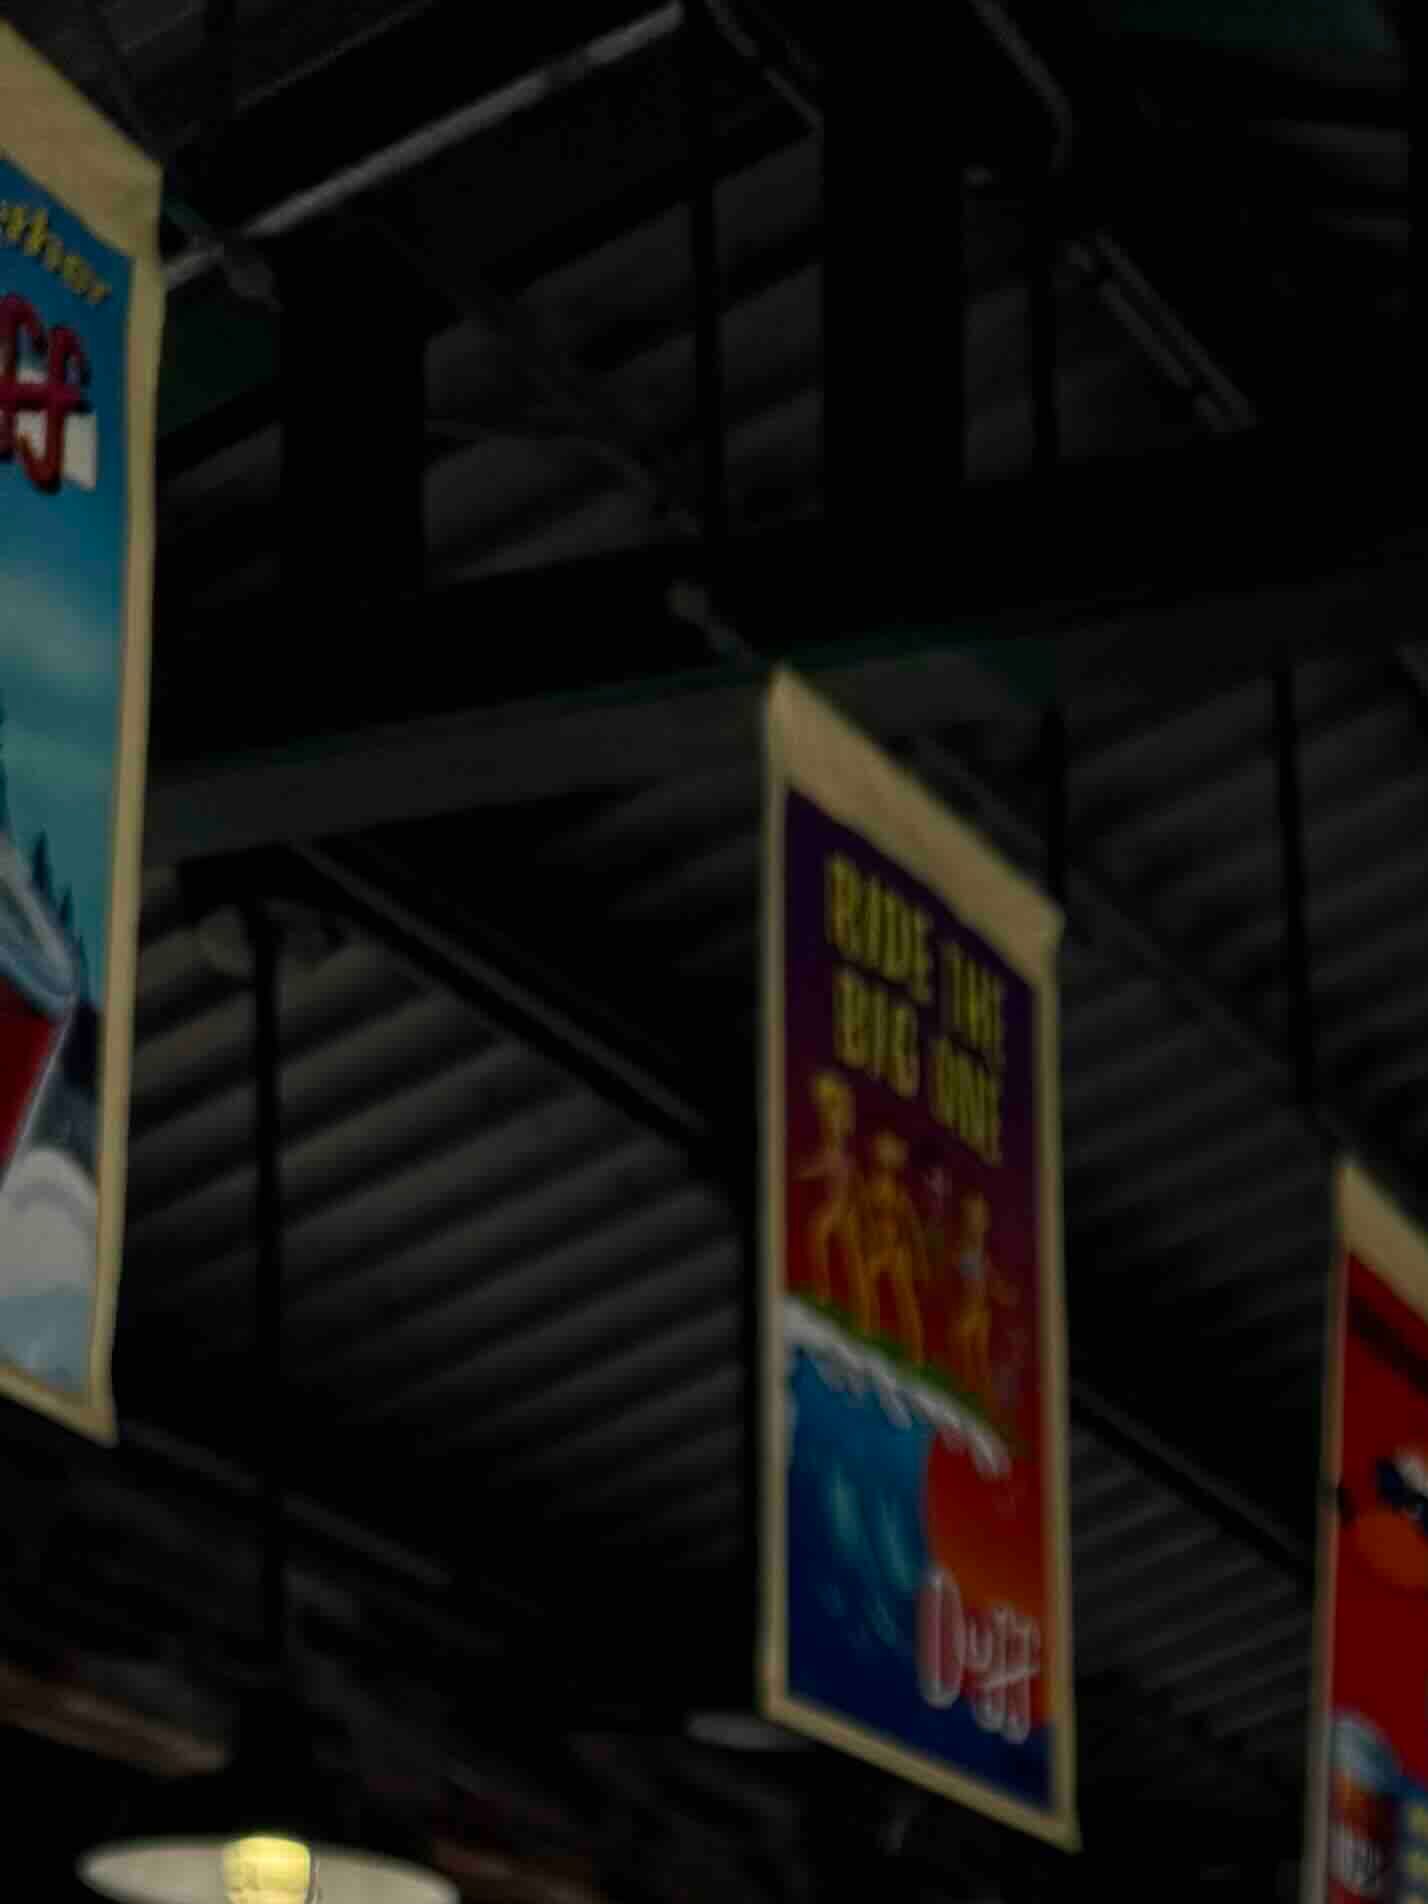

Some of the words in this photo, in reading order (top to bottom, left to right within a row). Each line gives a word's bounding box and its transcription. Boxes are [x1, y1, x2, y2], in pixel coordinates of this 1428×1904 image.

[824, 850, 932, 1005] RIDE
[938, 940, 1006, 1076] THE
[831, 962, 920, 1102] BIG
[928, 1037, 1004, 1169] ONE
[914, 1567, 1041, 1743] Duff
